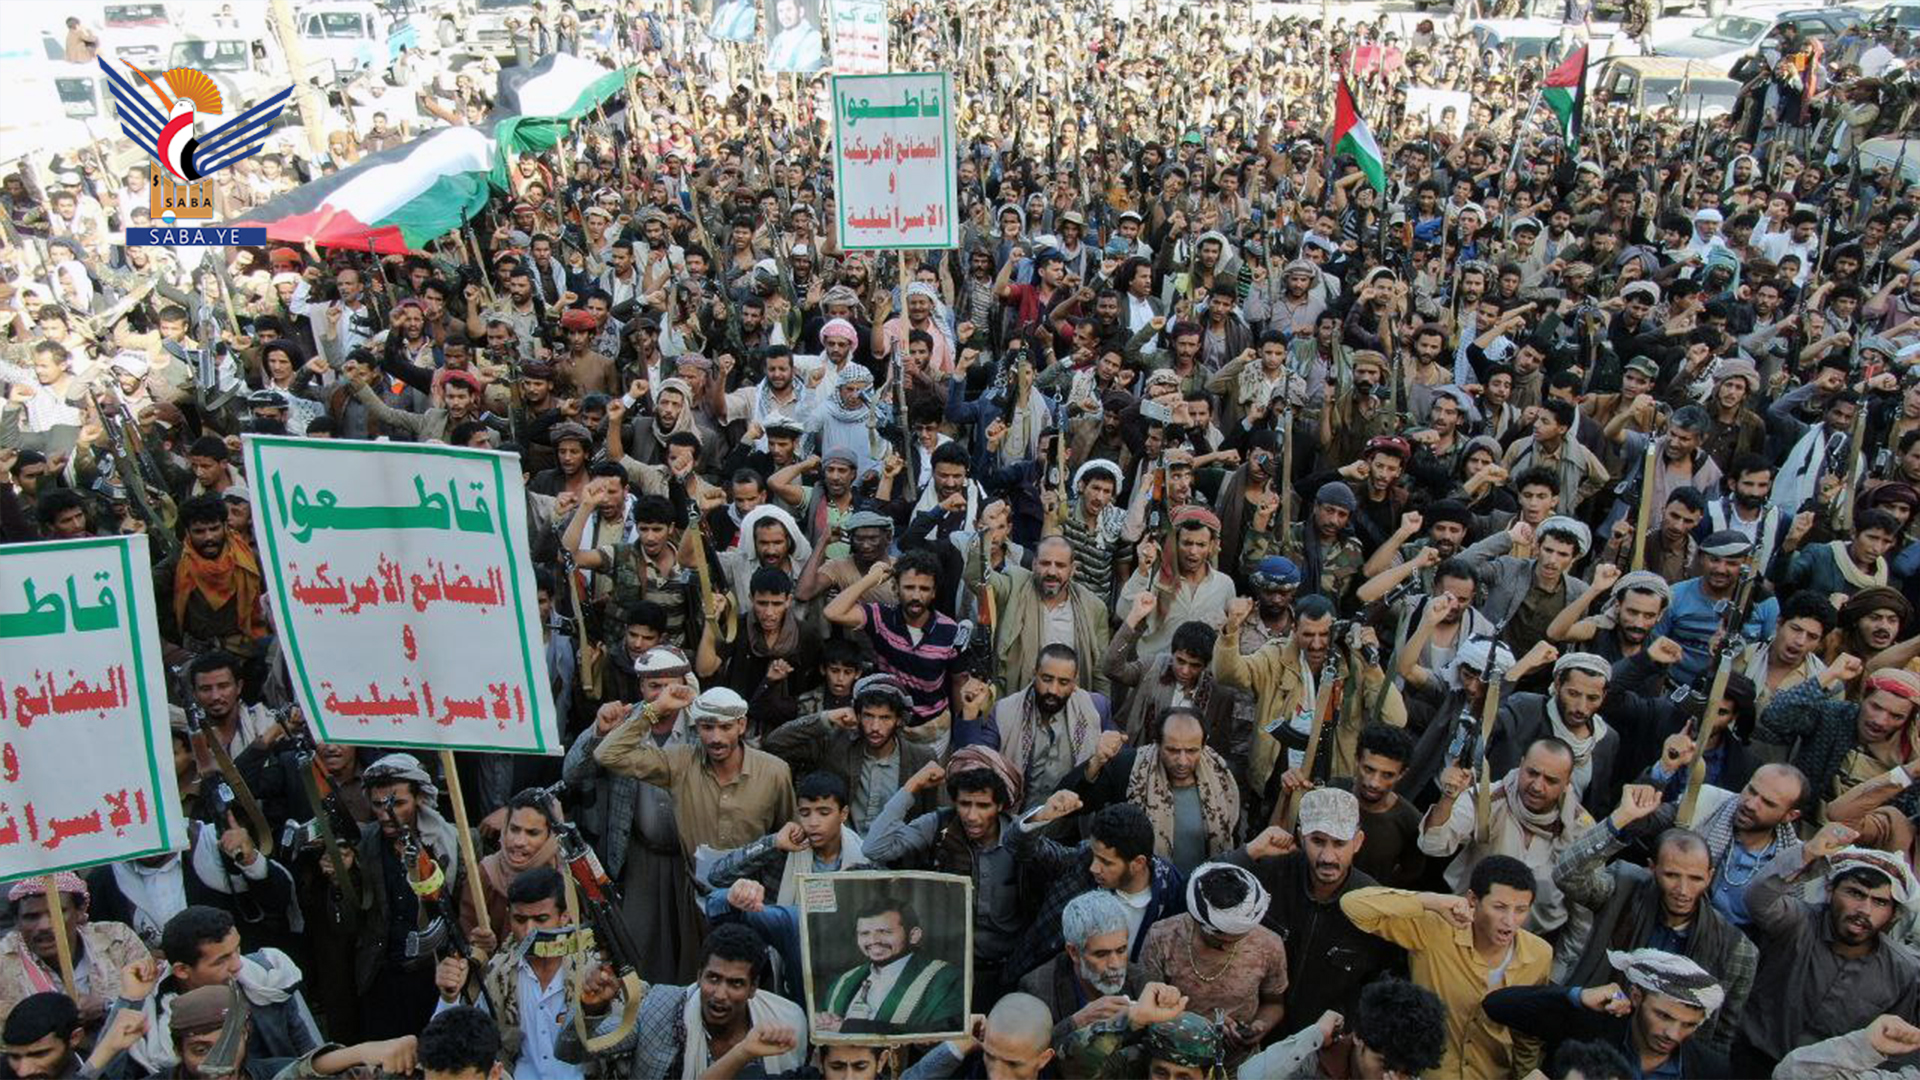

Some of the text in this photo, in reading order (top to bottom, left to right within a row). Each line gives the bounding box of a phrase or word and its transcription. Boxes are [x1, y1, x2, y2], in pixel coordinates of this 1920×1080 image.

[841, 88, 939, 126] قاطعوا
[896, 135, 940, 165] البضائع
[888, 171, 896, 194] و
[272, 469, 495, 543] قاطعوا
[0, 570, 119, 638] قاط
[289, 551, 505, 614] البضائع الأمريكية
[402, 623, 418, 661] و
[14, 663, 129, 730] البضائع
[320, 677, 525, 730] الإسرائيلية
[3, 741, 20, 783] و
[0, 788, 147, 850] الإسرائ
